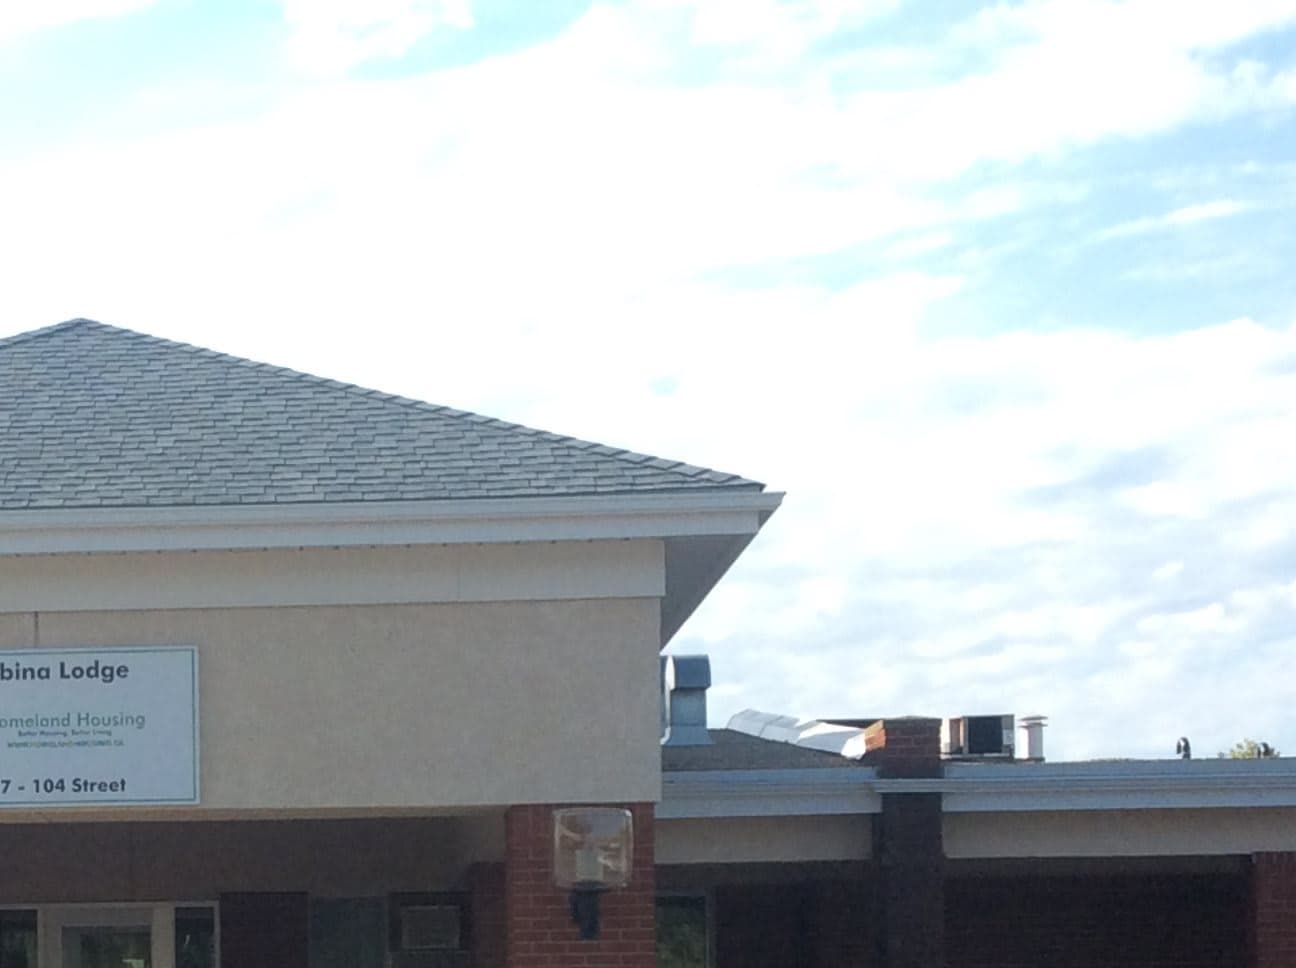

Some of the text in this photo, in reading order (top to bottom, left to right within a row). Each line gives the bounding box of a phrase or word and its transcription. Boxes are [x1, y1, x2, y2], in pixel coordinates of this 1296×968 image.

[59, 660, 130, 684] Lodge
[77, 710, 146, 729] Housing
[33, 778, 65, 794] 104
[72, 778, 126, 793] Street
